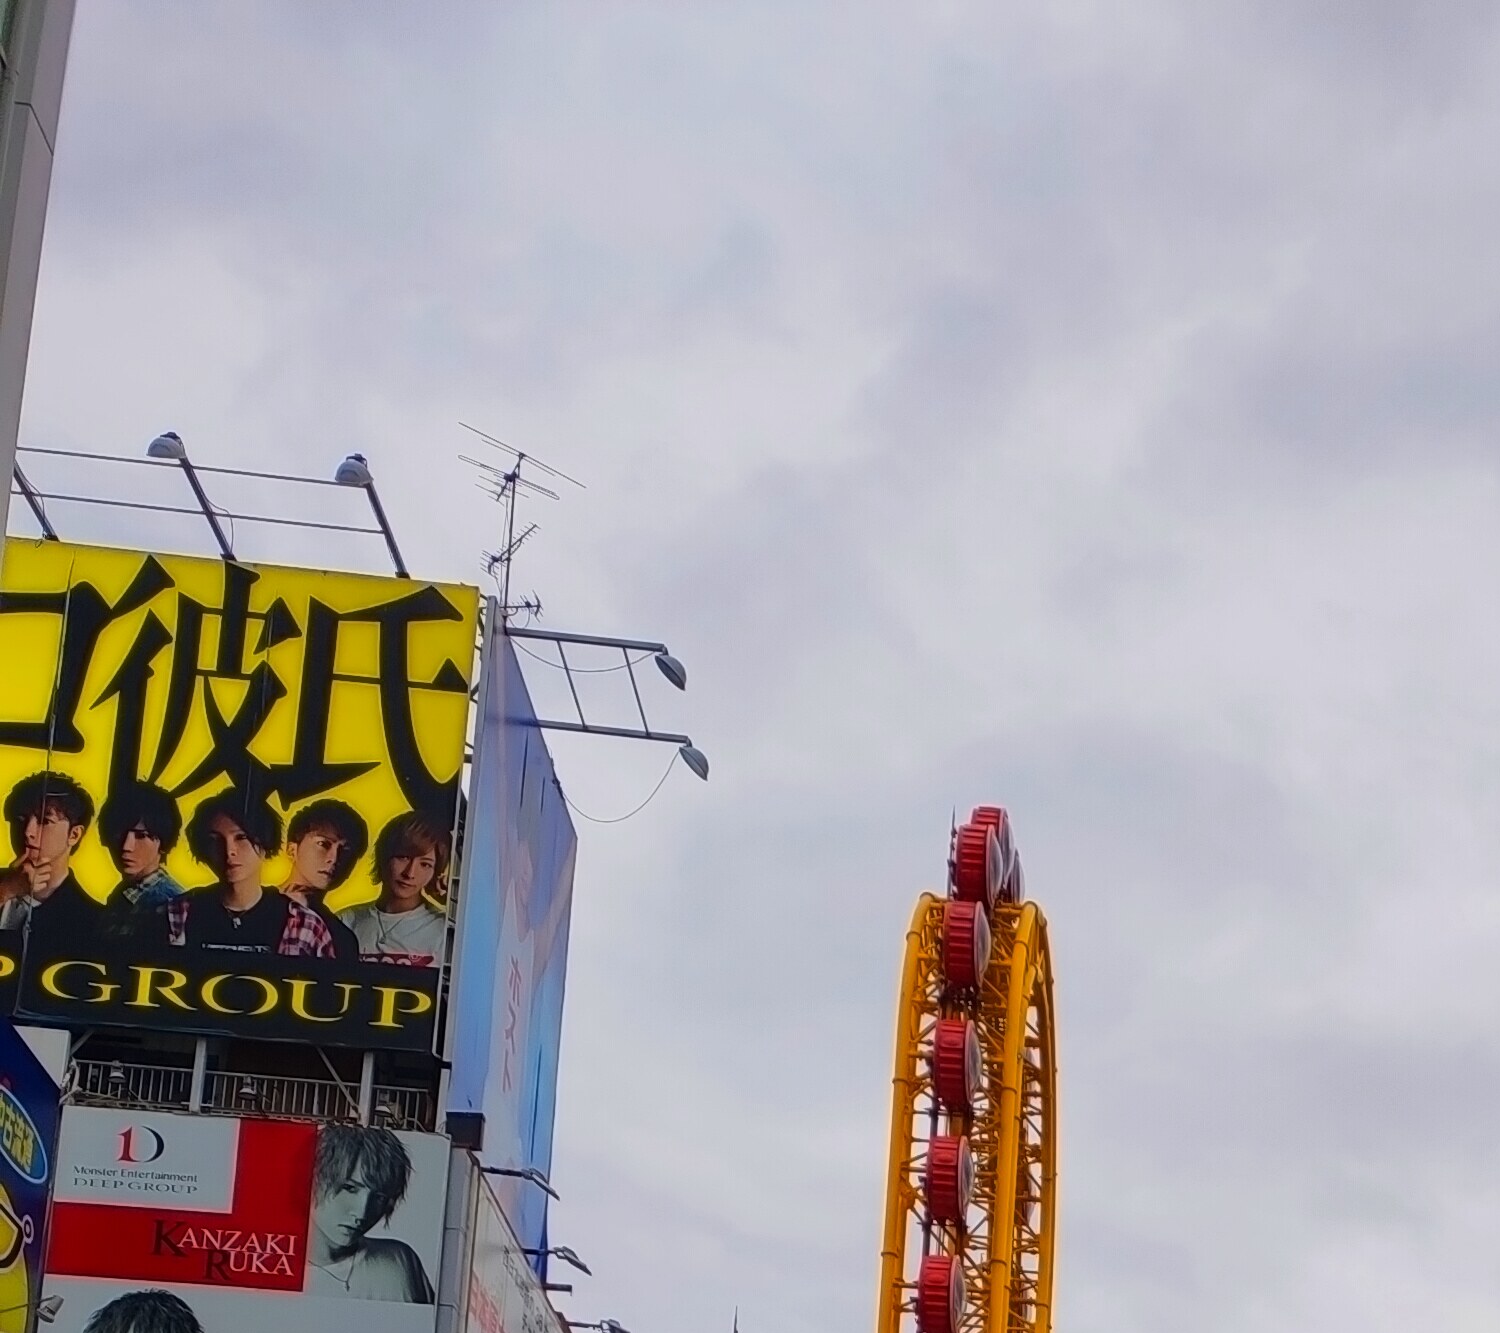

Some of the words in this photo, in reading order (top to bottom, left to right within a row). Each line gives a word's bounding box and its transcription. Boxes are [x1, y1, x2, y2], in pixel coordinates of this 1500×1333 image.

[41, 960, 433, 1029] GROUP
[73, 1165, 118, 1180] Monster
[120, 1167, 198, 1184] Entertainment
[73, 1177, 125, 1191] DEEP
[127, 1181, 198, 1195] GROUP
[153, 1219, 298, 1259] KANZAKI
[204, 1247, 295, 1282] RUKA
